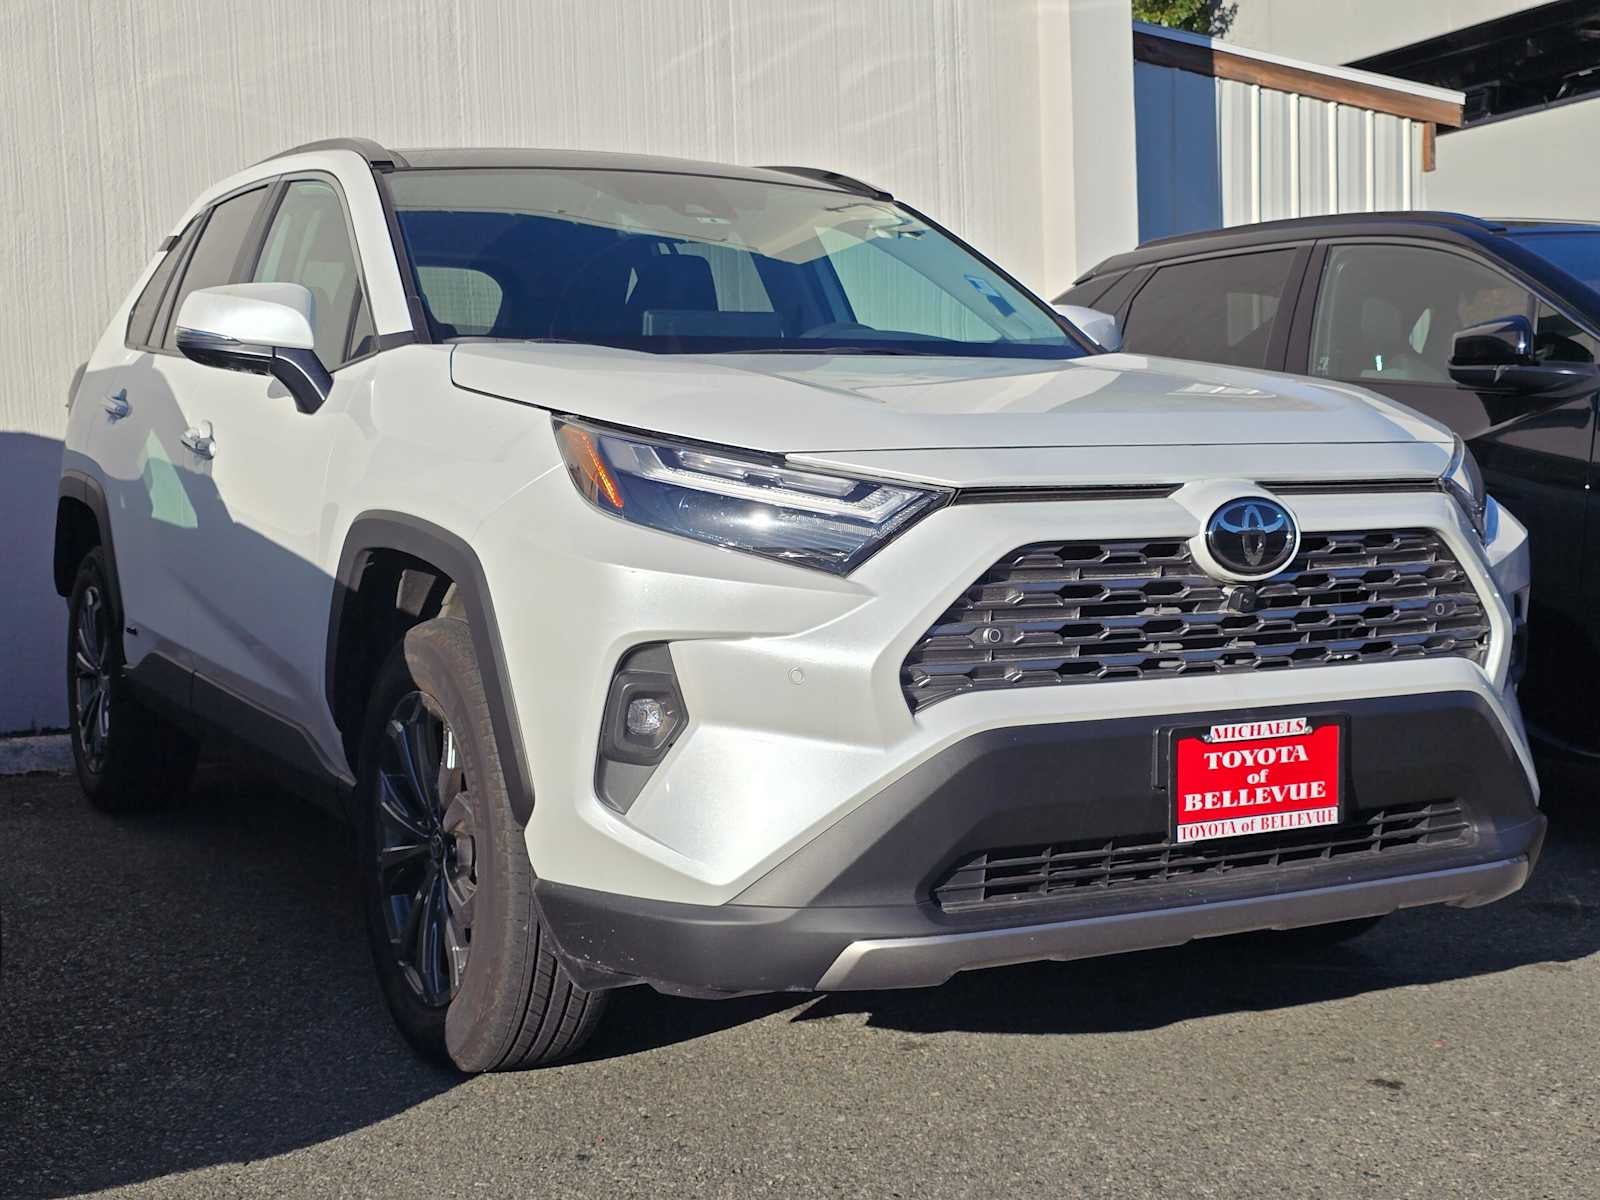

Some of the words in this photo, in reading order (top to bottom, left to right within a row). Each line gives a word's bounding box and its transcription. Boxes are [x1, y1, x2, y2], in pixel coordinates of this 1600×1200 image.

[1214, 720, 1304, 740] MICHAELS
[1204, 745, 1308, 770] TOYOTA
[1247, 769, 1269, 784] of
[1184, 781, 1326, 812] BELLEVUE
[1180, 821, 1236, 840] TOYOTA
[1241, 819, 1256, 833] of
[1260, 809, 1336, 831] BELLEVUE
